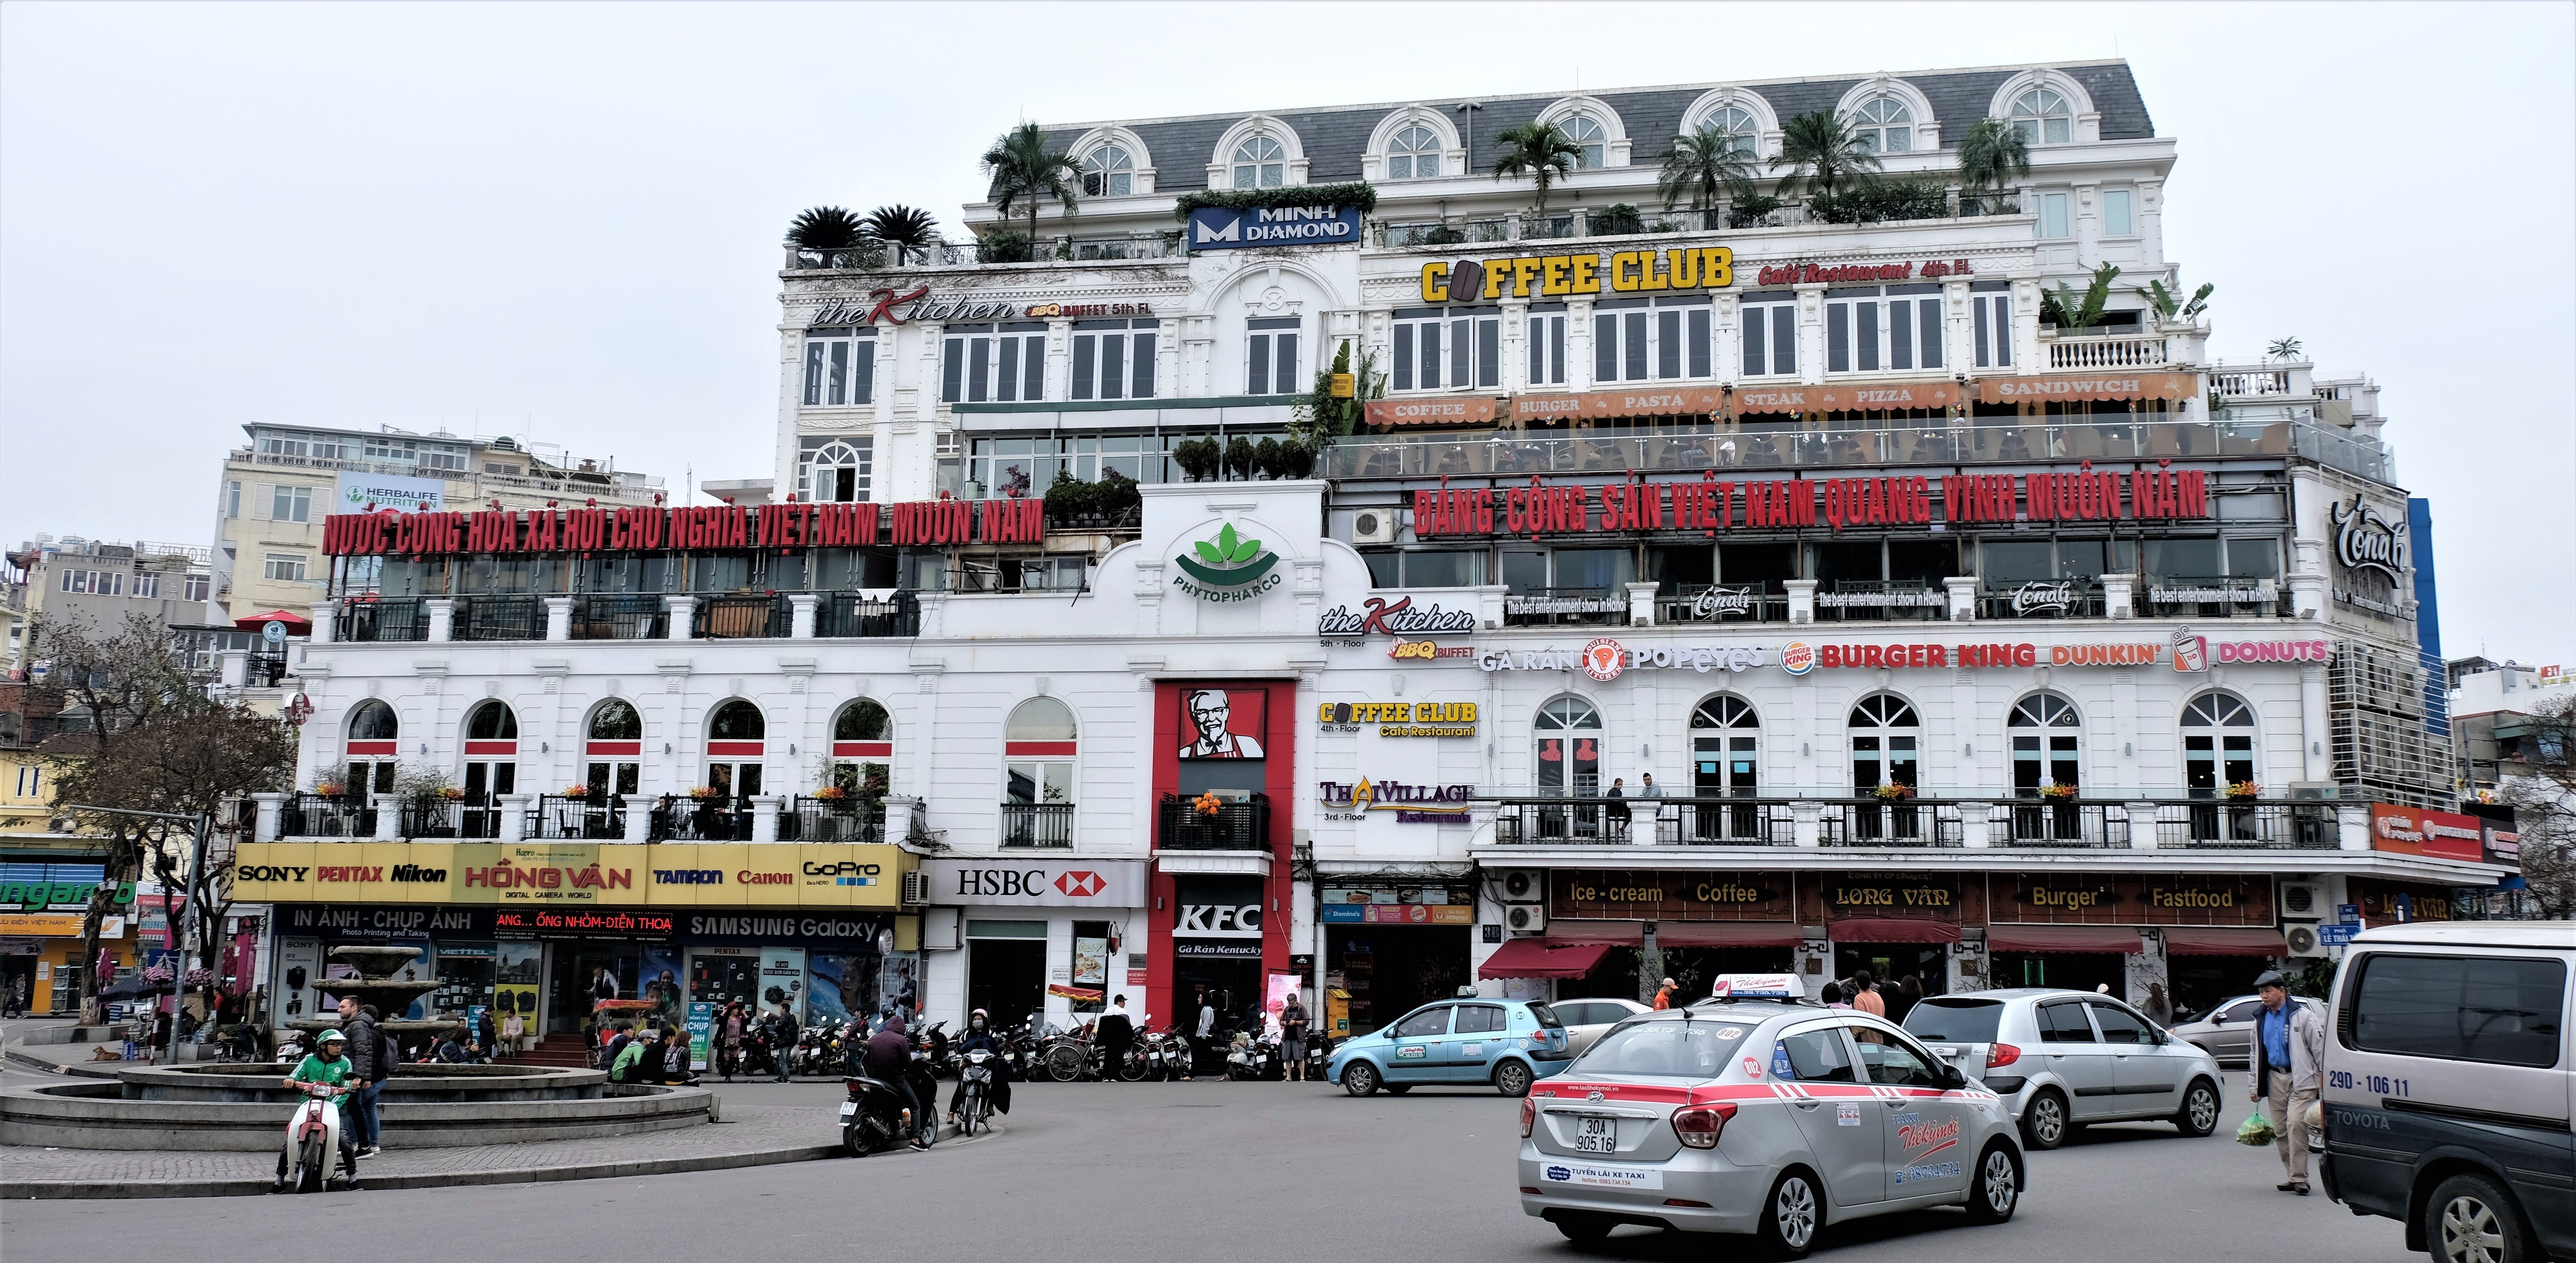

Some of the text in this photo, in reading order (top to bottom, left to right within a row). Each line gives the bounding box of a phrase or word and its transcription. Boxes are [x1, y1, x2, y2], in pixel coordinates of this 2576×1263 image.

[1259, 206, 1336, 223] MINH
[1247, 222, 1350, 240] DIAMOND
[1421, 247, 1734, 303] COFFEE CLUB
[1758, 259, 1974, 286] Café Restaurant 4th Fl.
[1030, 303, 1061, 317] BBQ
[1063, 304, 1106, 317] BUFFET
[1112, 303, 1133, 314] 5th
[1138, 302, 1151, 314] Fl.
[1999, 380, 2140, 395] SANDWICH
[1519, 394, 1685, 413] BURGER PASTA
[1744, 389, 1913, 405] STEAK PIZZA
[1394, 404, 1466, 417] COFFEE
[367, 488, 438, 500] HERBALIFE
[1413, 458, 2206, 543] ĐẢNG CỘNG SẢN VIỆT NAM QUANG VINH MUÔN NĂM
[396, 501, 463, 563] CỘNG
[523, 499, 559, 551] XÃ
[563, 497, 607, 560] HỘI
[612, 493, 664, 550] CHỦ
[668, 495, 747, 549] NGHĨA
[758, 493, 814, 556] VIỆT
[817, 502, 880, 546] NAM
[891, 490, 973, 545] MUÔN
[982, 488, 1044, 544] NĂM
[1173, 574, 1281, 603] PHYTOPHARCO
[1507, 597, 1626, 615] The best entertainment show Hanoi
[1820, 591, 1944, 606] The best entertainment show Hanoi
[1394, 642, 1475, 660] BBQ BUFFET
[1583, 639, 1624, 656] LOUISIANA
[1784, 647, 1810, 657] BURGER
[1822, 643, 2035, 668] BURGER KING
[2052, 643, 2161, 666] DUNKIN'
[2219, 641, 2327, 663] DONUTS
[1479, 645, 1575, 672] GÀ RÁN
[1786, 653, 1812, 666] KING
[1585, 666, 1622, 680] KITCHEN
[1320, 702, 1476, 723] COFFEE CLUB
[1379, 726, 1475, 736] Cafe Restaurant
[1396, 811, 1471, 823] Restaurants
[516, 848, 535, 857] Hapro
[238, 863, 447, 883] SONY PENTAX Nikon
[465, 858, 632, 889] HỒNG VÂN
[803, 861, 880, 875] GoPro
[653, 870, 793, 884] TAMRON Canon
[957, 869, 1045, 897] HSBC
[1571, 883, 1757, 901] Ice cream Coffee
[1836, 885, 1950, 905] LONG VÂN
[2033, 887, 2233, 910] Burger Fastfood
[141, 918, 166, 929] HÙNG
[295, 905, 472, 931] IN ẢNH CHỤP ẢNH
[536, 912, 562, 927] ỐNG
[1176, 904, 1261, 931] KFC
[364, 929, 390, 937] Printing
[408, 930, 429, 938] Taking
[691, 916, 795, 936] SAMSUNG
[800, 918, 878, 942] Galaxy
[1179, 945, 1263, 956] Gà Rán Kentucky
[687, 1021, 708, 1033] CHỤP
[1717, 1029, 1740, 1038] 802
[1744, 1061, 1760, 1075] 802
[2330, 1070, 2409, 1097] 29D 106 11
[1892, 1112, 1920, 1124] TAXI
[2333, 1109, 2391, 1131] TOYOTA
[1586, 1120, 1606, 1135] 30A
[1577, 1136, 1613, 1152] 905.16
[1571, 1166, 1597, 1176] TUYỂN
[1598, 1169, 1610, 1178] LÁI
[1909, 1161, 1961, 1182] 38.734.734
